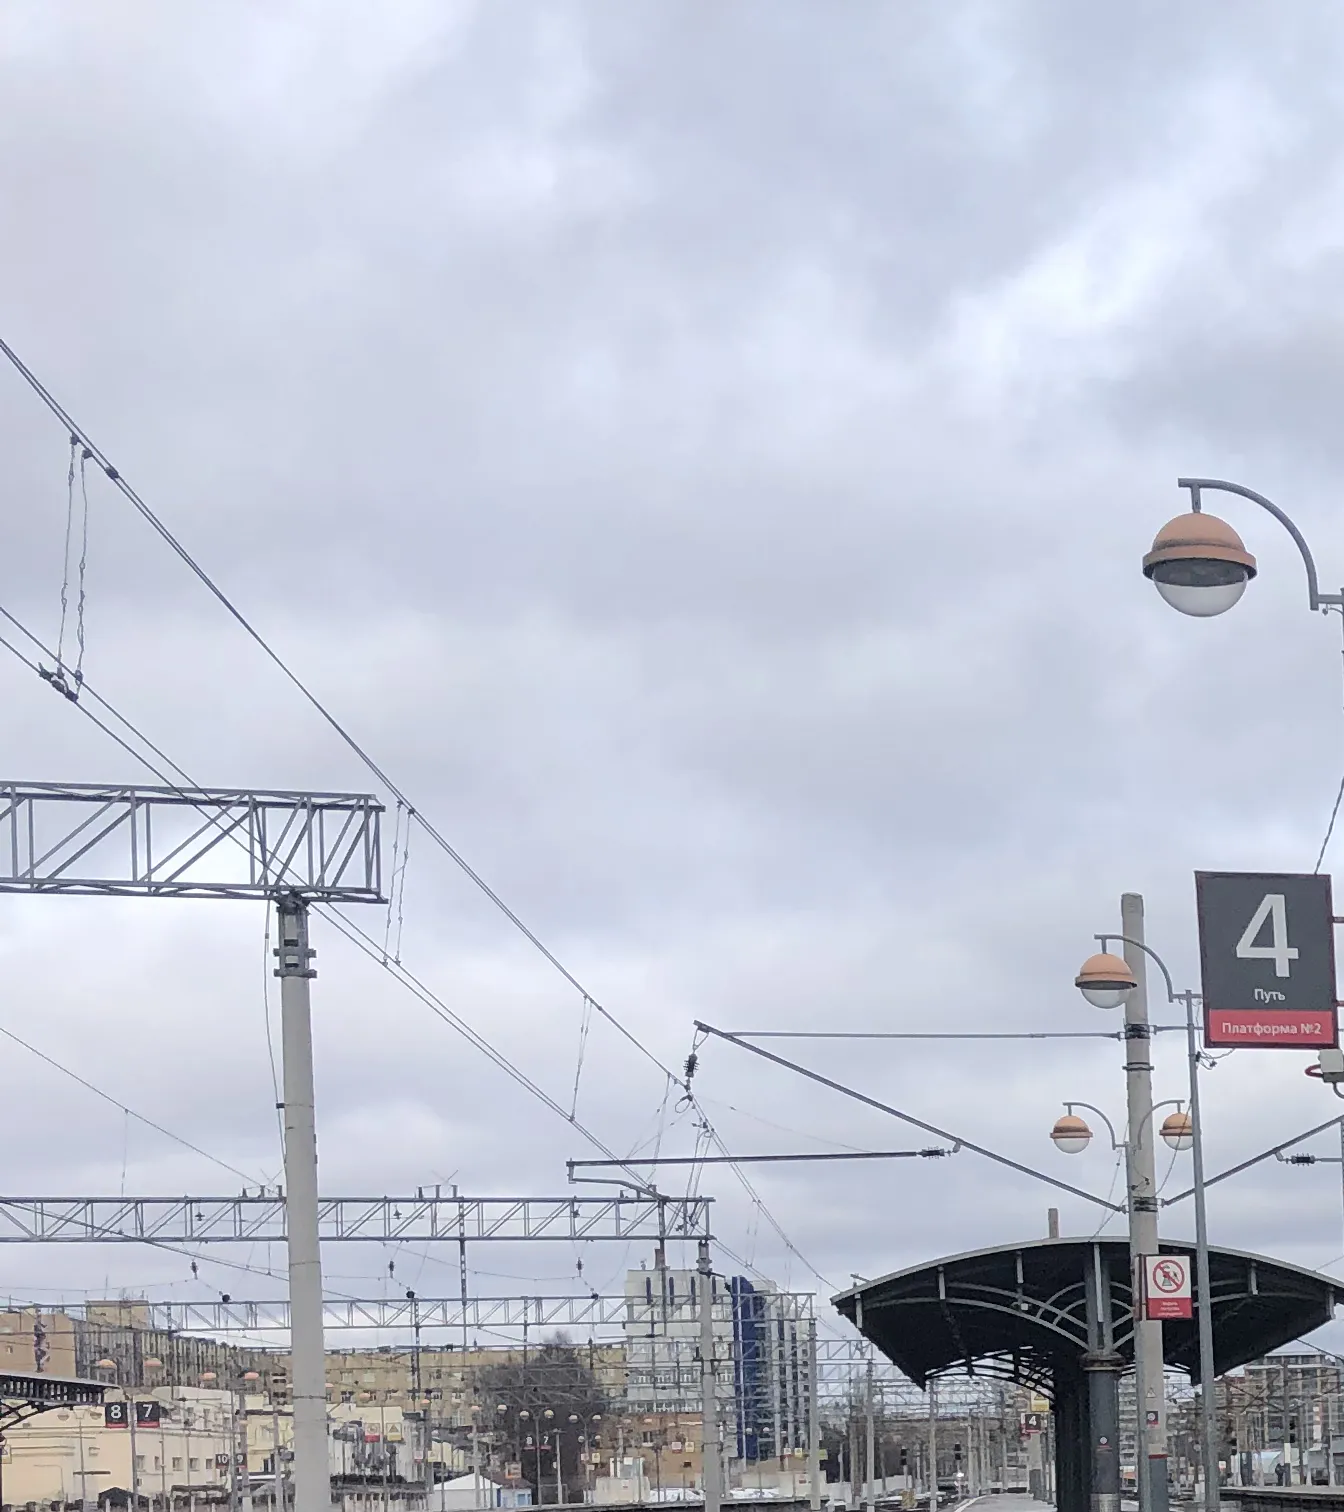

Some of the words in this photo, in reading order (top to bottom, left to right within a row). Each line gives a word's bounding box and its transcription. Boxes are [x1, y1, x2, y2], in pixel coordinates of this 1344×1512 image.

[1236, 894, 1299, 977] 4
[1254, 988, 1286, 1003] Путь
[1222, 1022, 1298, 1036] Платформа
[1300, 1023, 1322, 1035] №2
[110, 1404, 122, 1419] 8
[142, 1404, 153, 1418] 7
[1029, 1416, 1037, 1426] 4
[217, 1455, 228, 1464] 10
[237, 1454, 244, 1463] 9
